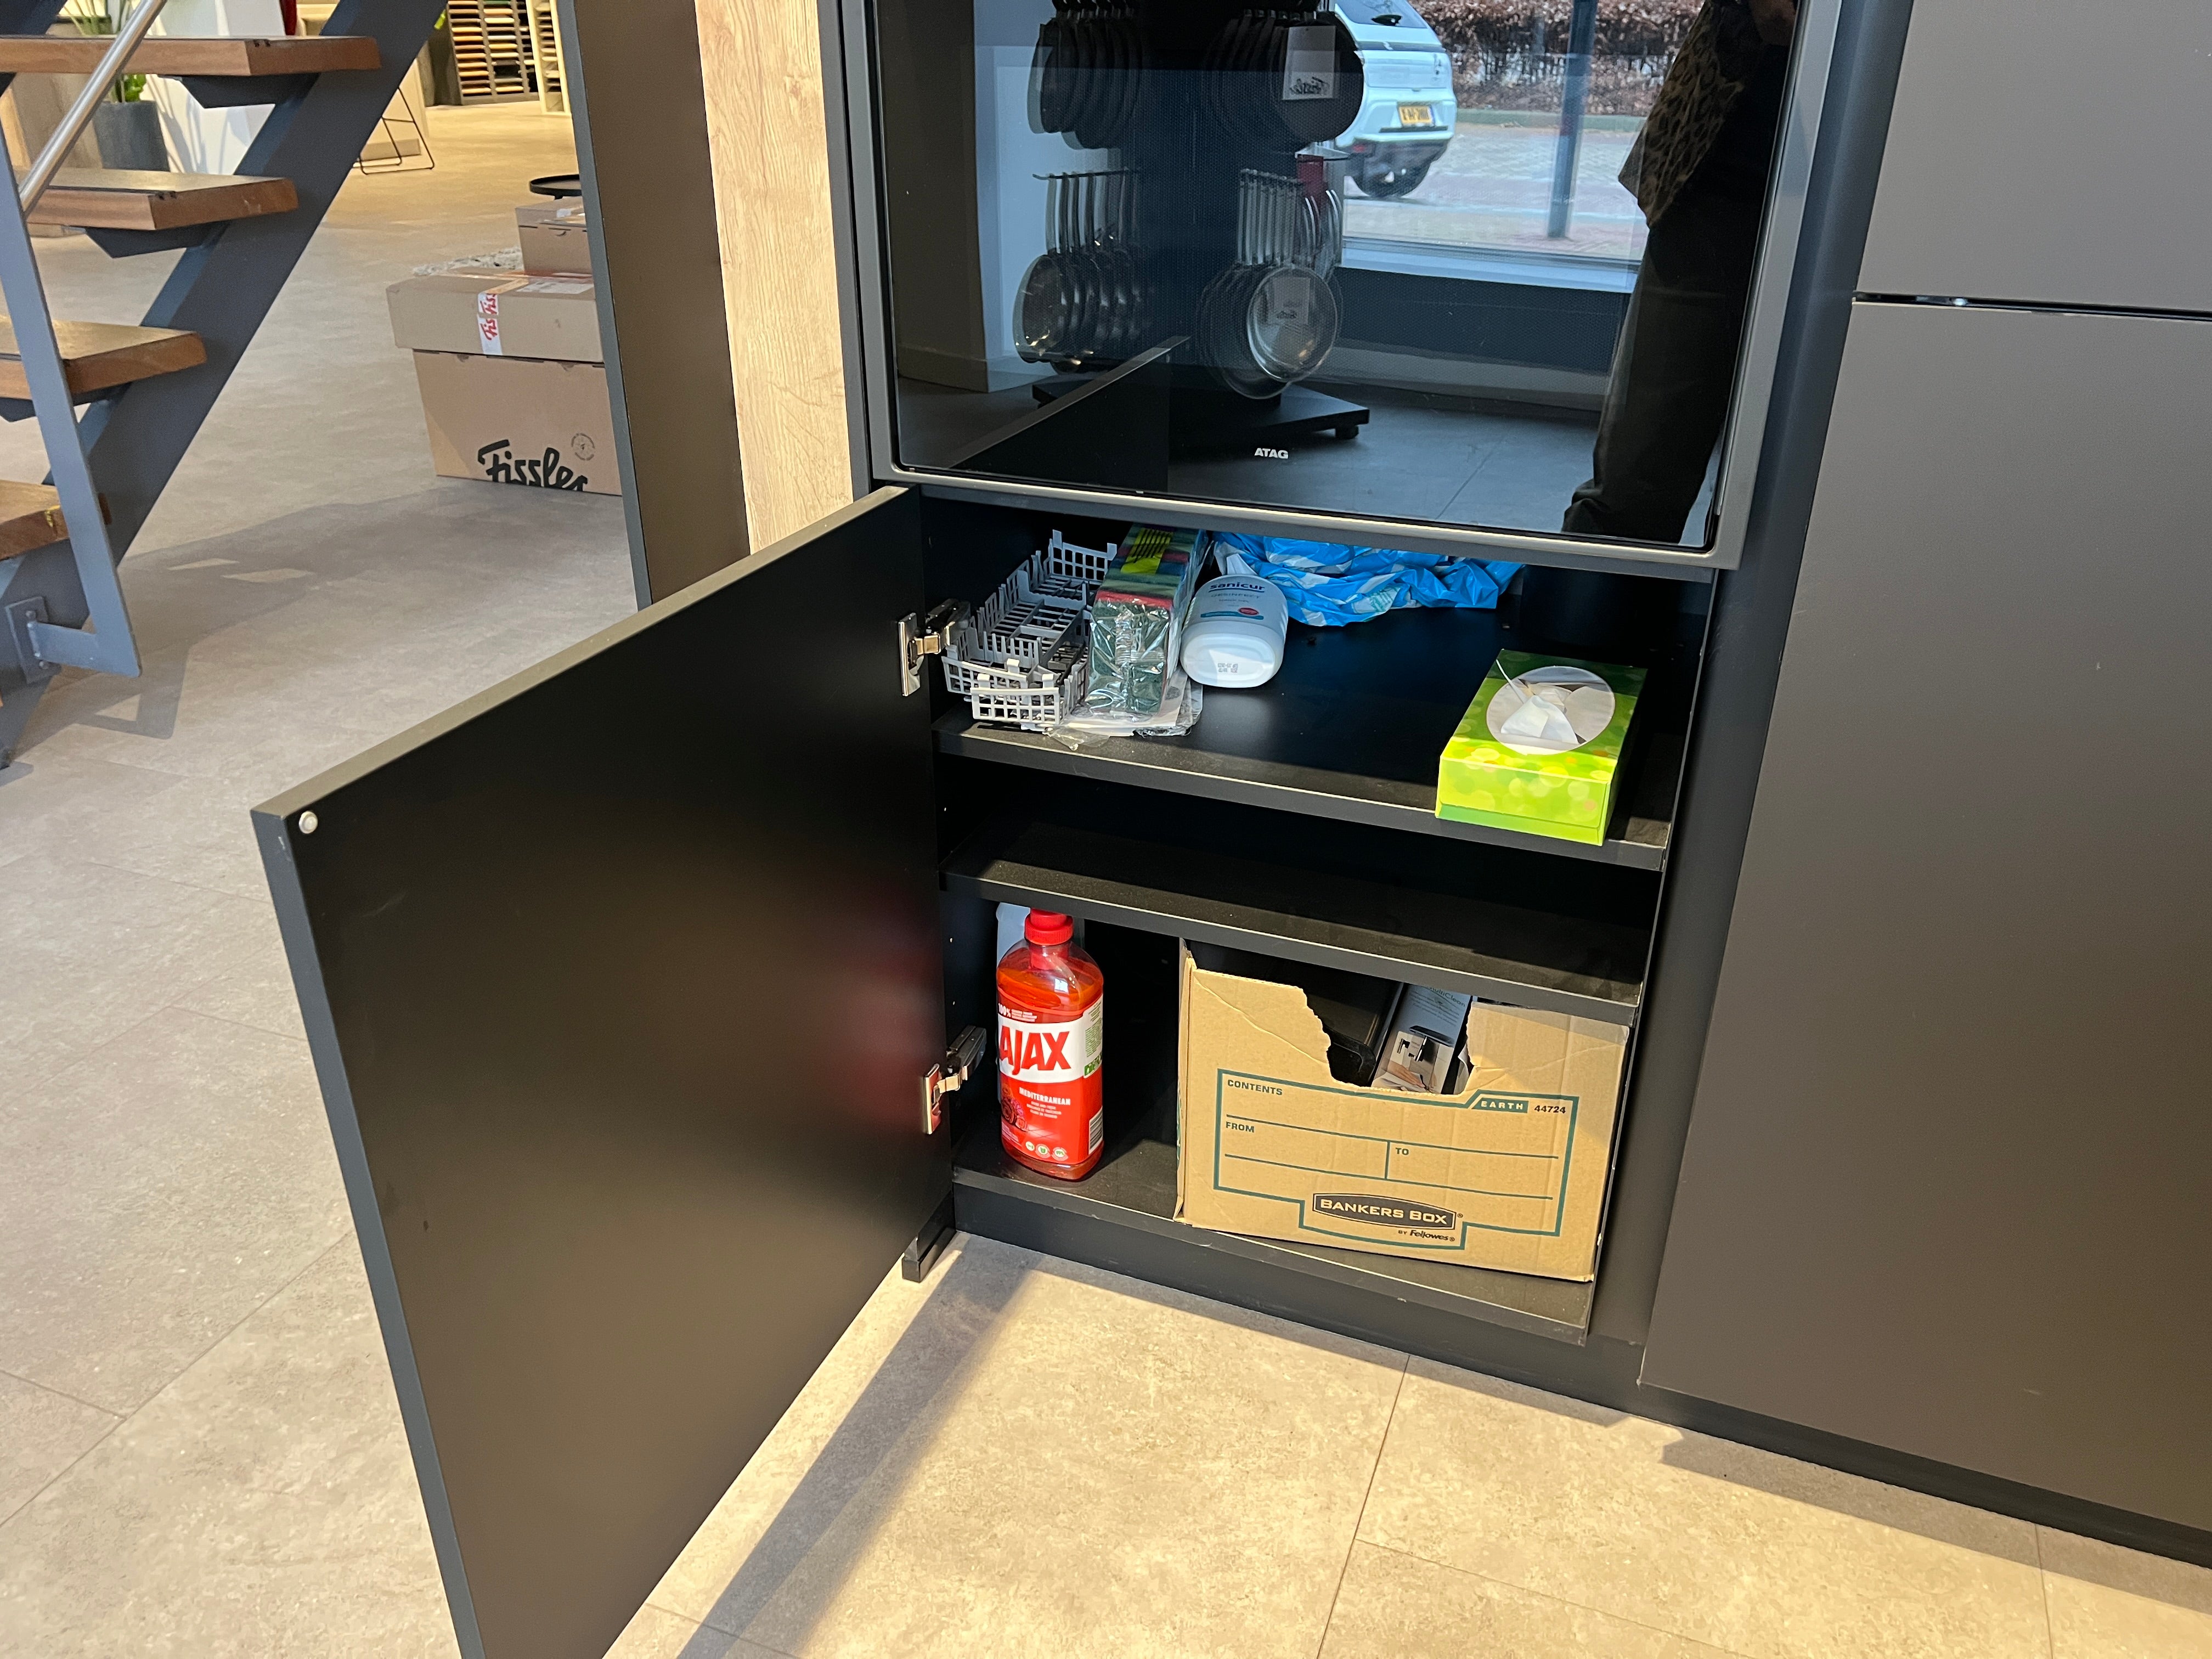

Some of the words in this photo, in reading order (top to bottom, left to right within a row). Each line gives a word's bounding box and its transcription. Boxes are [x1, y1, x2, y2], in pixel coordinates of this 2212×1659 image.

[1254, 448, 1289, 459] ATAG
[478, 439, 588, 492] Fissler
[1210, 582, 1265, 590] sanicur
[998, 1025, 1071, 1075] AJAX
[1227, 1079, 1283, 1096] CONTENTS
[1019, 1087, 1071, 1105] MEDITERRANEAN
[1481, 1100, 1523, 1110] EARTH
[1534, 1105, 1566, 1114] 44724
[1226, 1121, 1255, 1133] FROM
[1396, 1147, 1409, 1155] TO
[1320, 1199, 1404, 1218] BANKERS
[1409, 1210, 1447, 1224] BOX
